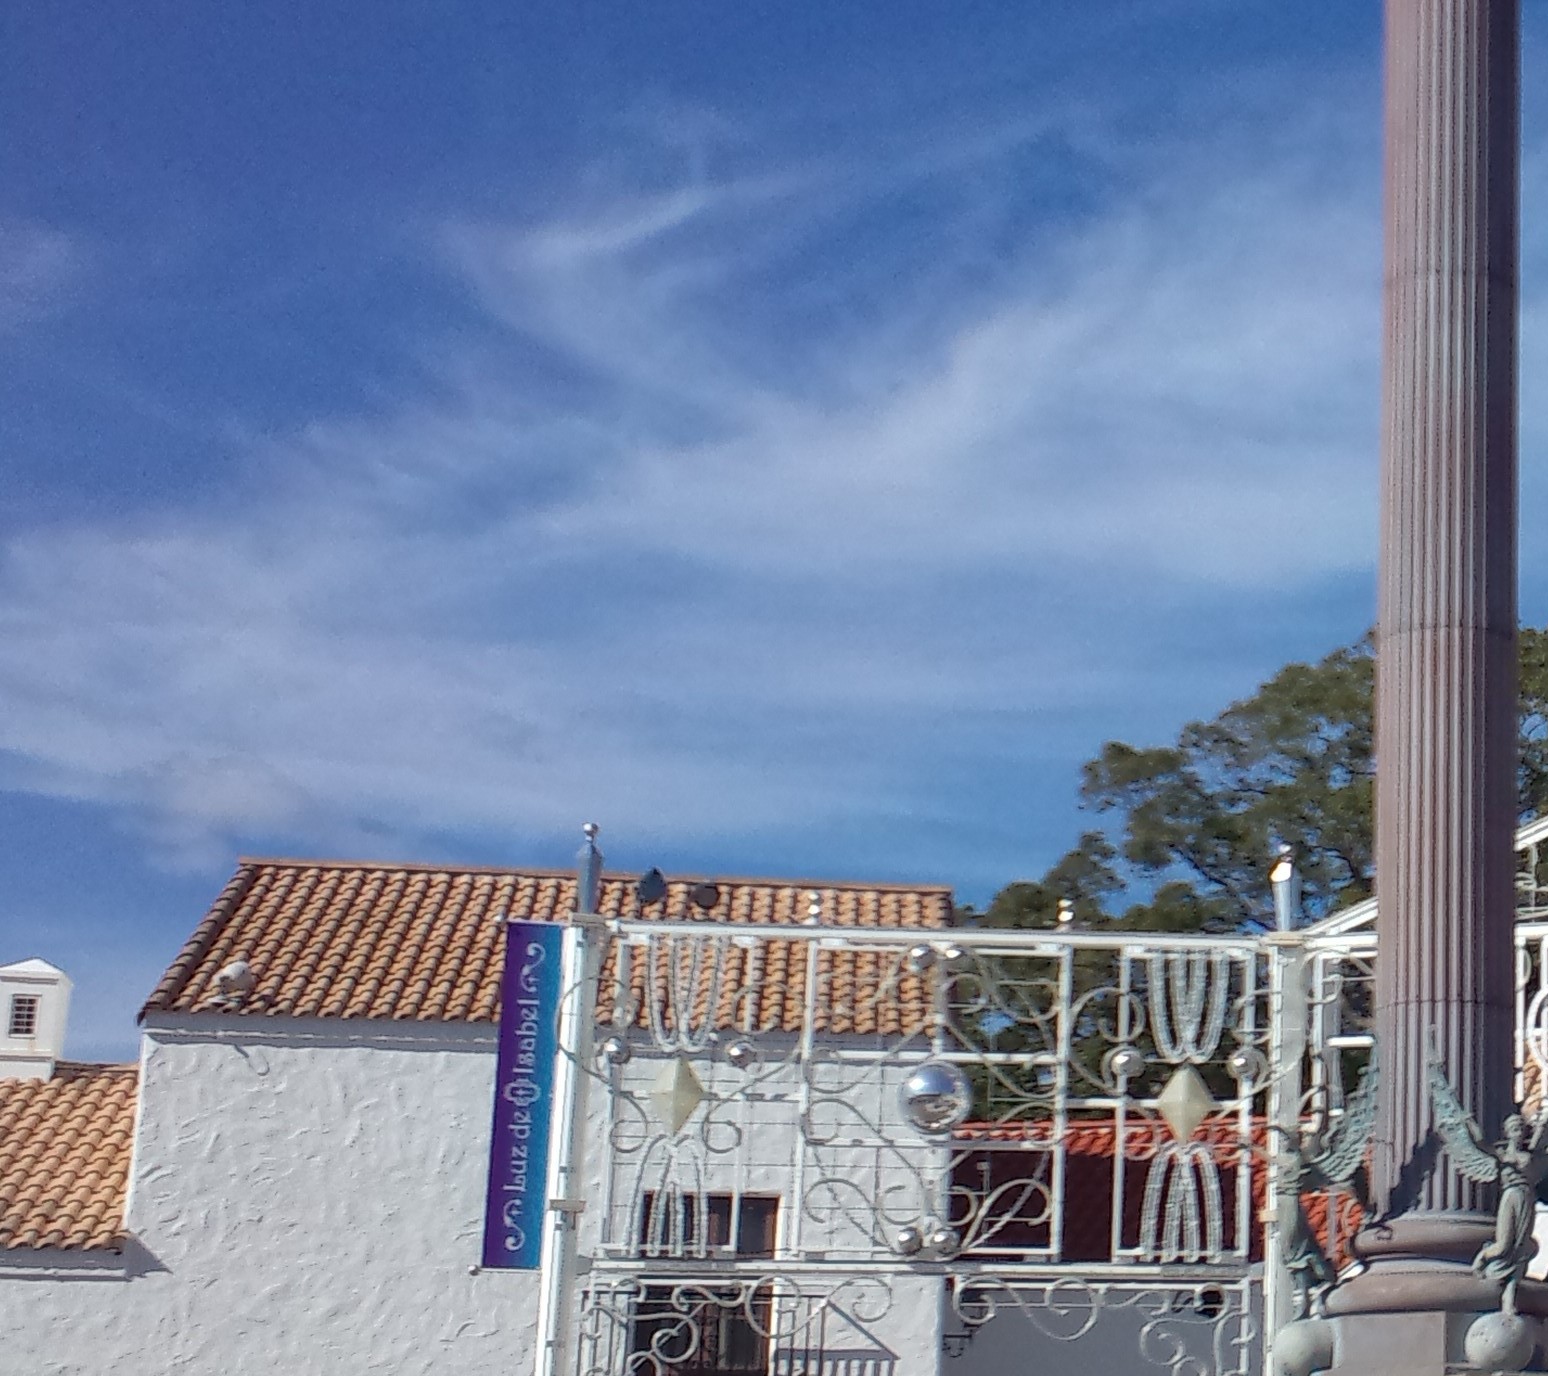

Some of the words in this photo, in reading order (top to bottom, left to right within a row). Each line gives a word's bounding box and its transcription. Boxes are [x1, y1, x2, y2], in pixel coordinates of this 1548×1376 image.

[512, 998, 541, 1075] Isabel
[508, 1110, 533, 1140] de
[502, 1144, 528, 1193] Luz
